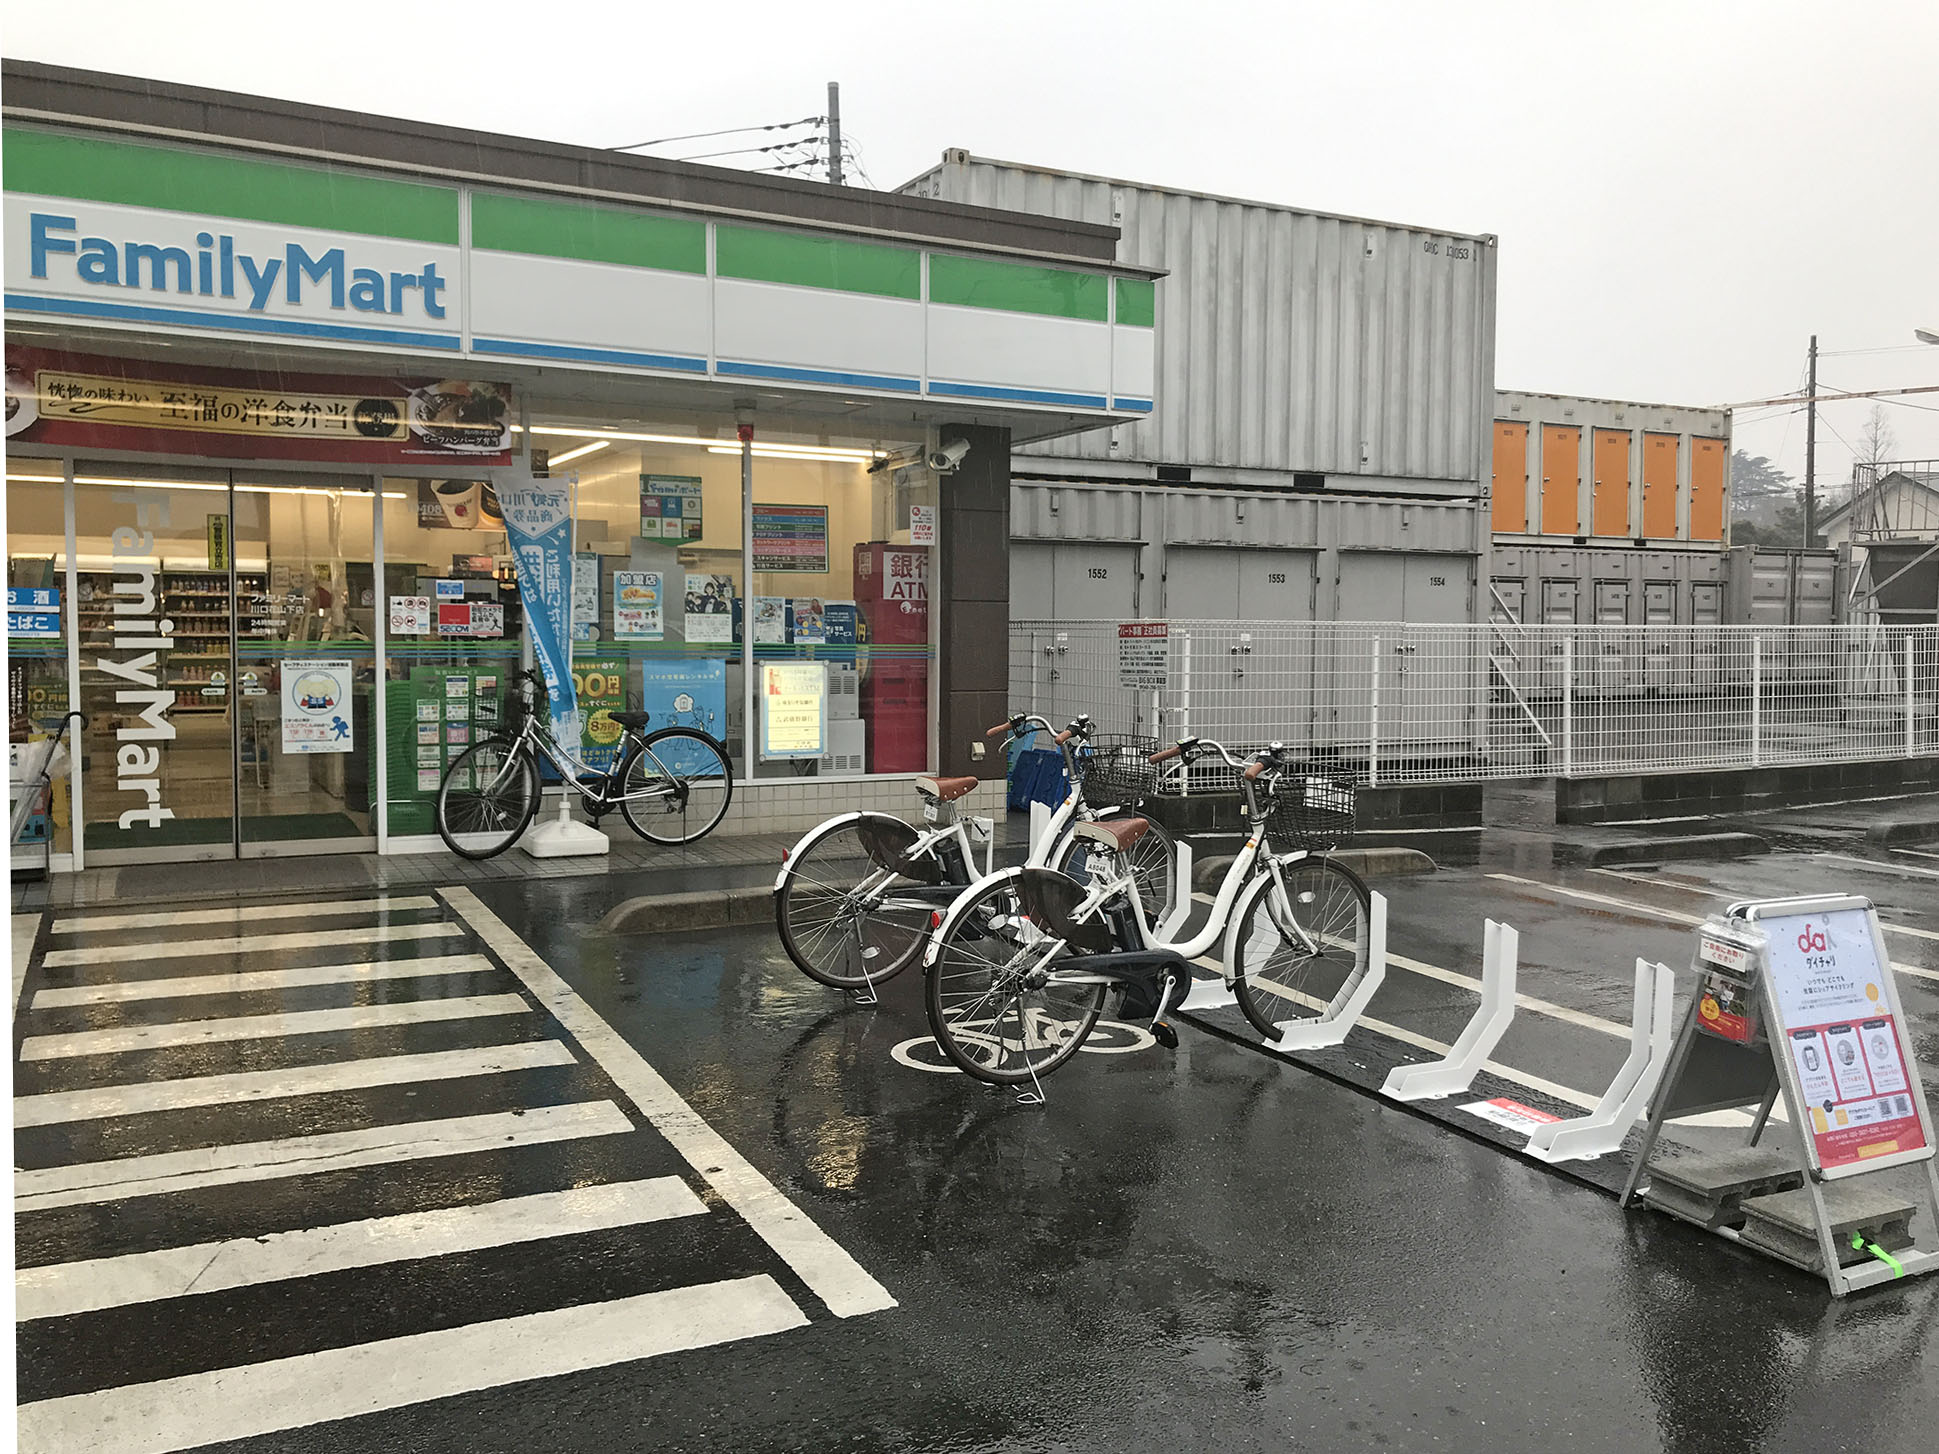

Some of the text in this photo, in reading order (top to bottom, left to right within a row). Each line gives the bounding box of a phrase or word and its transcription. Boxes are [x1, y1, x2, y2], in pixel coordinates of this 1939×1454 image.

[29, 211, 446, 320] FamilyMart
[159, 390, 348, 430] 至福の洋食弁当
[422, 435, 500, 446] ビーフハンバーグ弁当
[620, 573, 658, 586] 加盟店
[1088, 569, 1107, 579] 1552
[1268, 574, 1286, 584] 1553
[1430, 577, 1446, 586] 1554
[251, 594, 310, 604] ファミリーマート
[440, 625, 469, 633] SECOM
[97, 492, 177, 830] FamilyMart
[1711, 952, 1735, 963] ください
[1806, 955, 1836, 969] ダイチャリ
